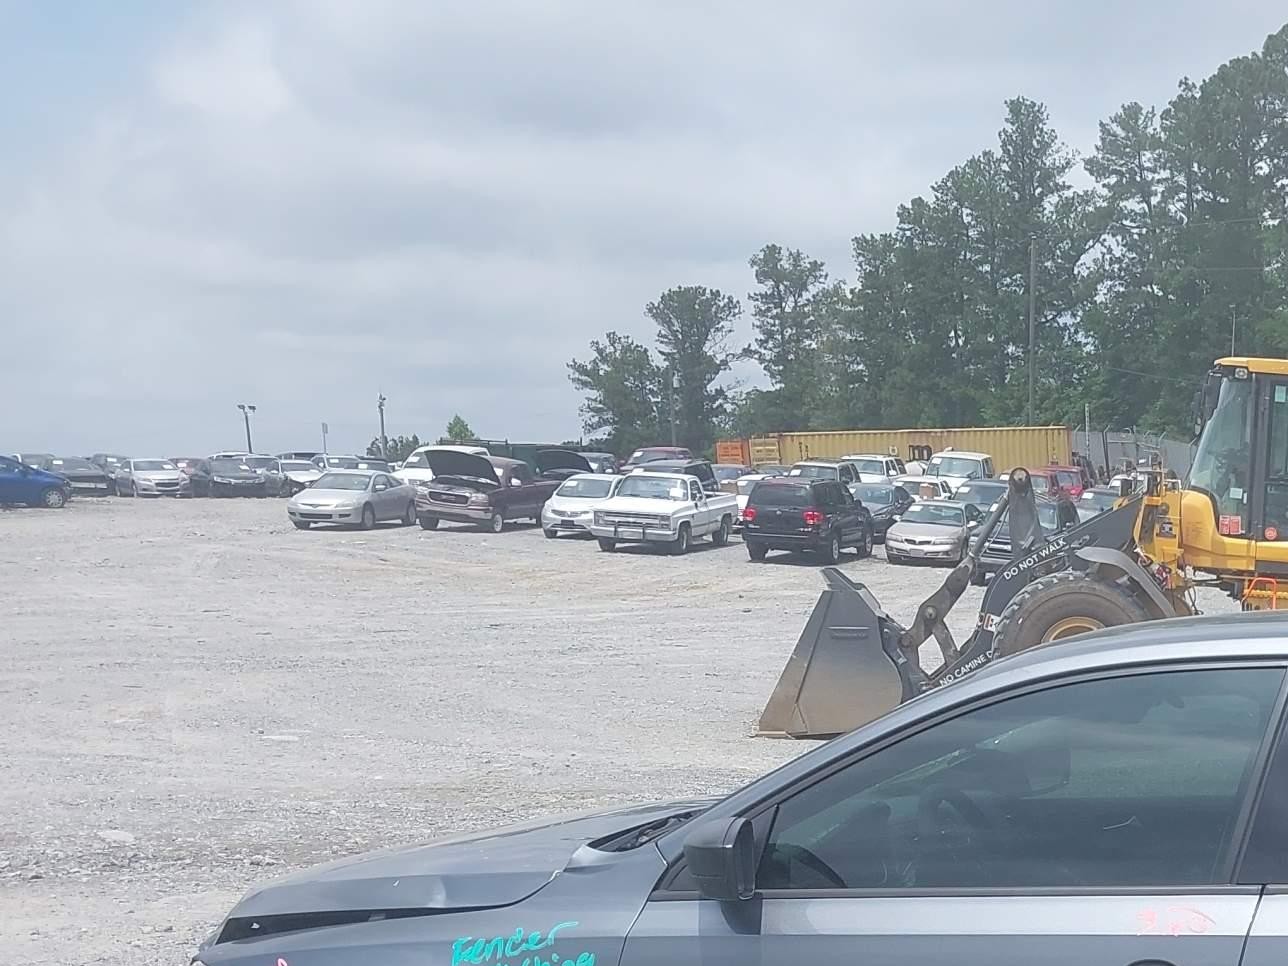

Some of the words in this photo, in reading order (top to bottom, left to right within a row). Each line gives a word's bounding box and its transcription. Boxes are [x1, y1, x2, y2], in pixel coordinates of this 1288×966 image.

[1003, 567, 1019, 580] DO
[1019, 555, 1039, 570] NOT
[1040, 538, 1066, 556] WALK
[939, 674, 955, 687] NO
[954, 654, 986, 677] CAMINE
